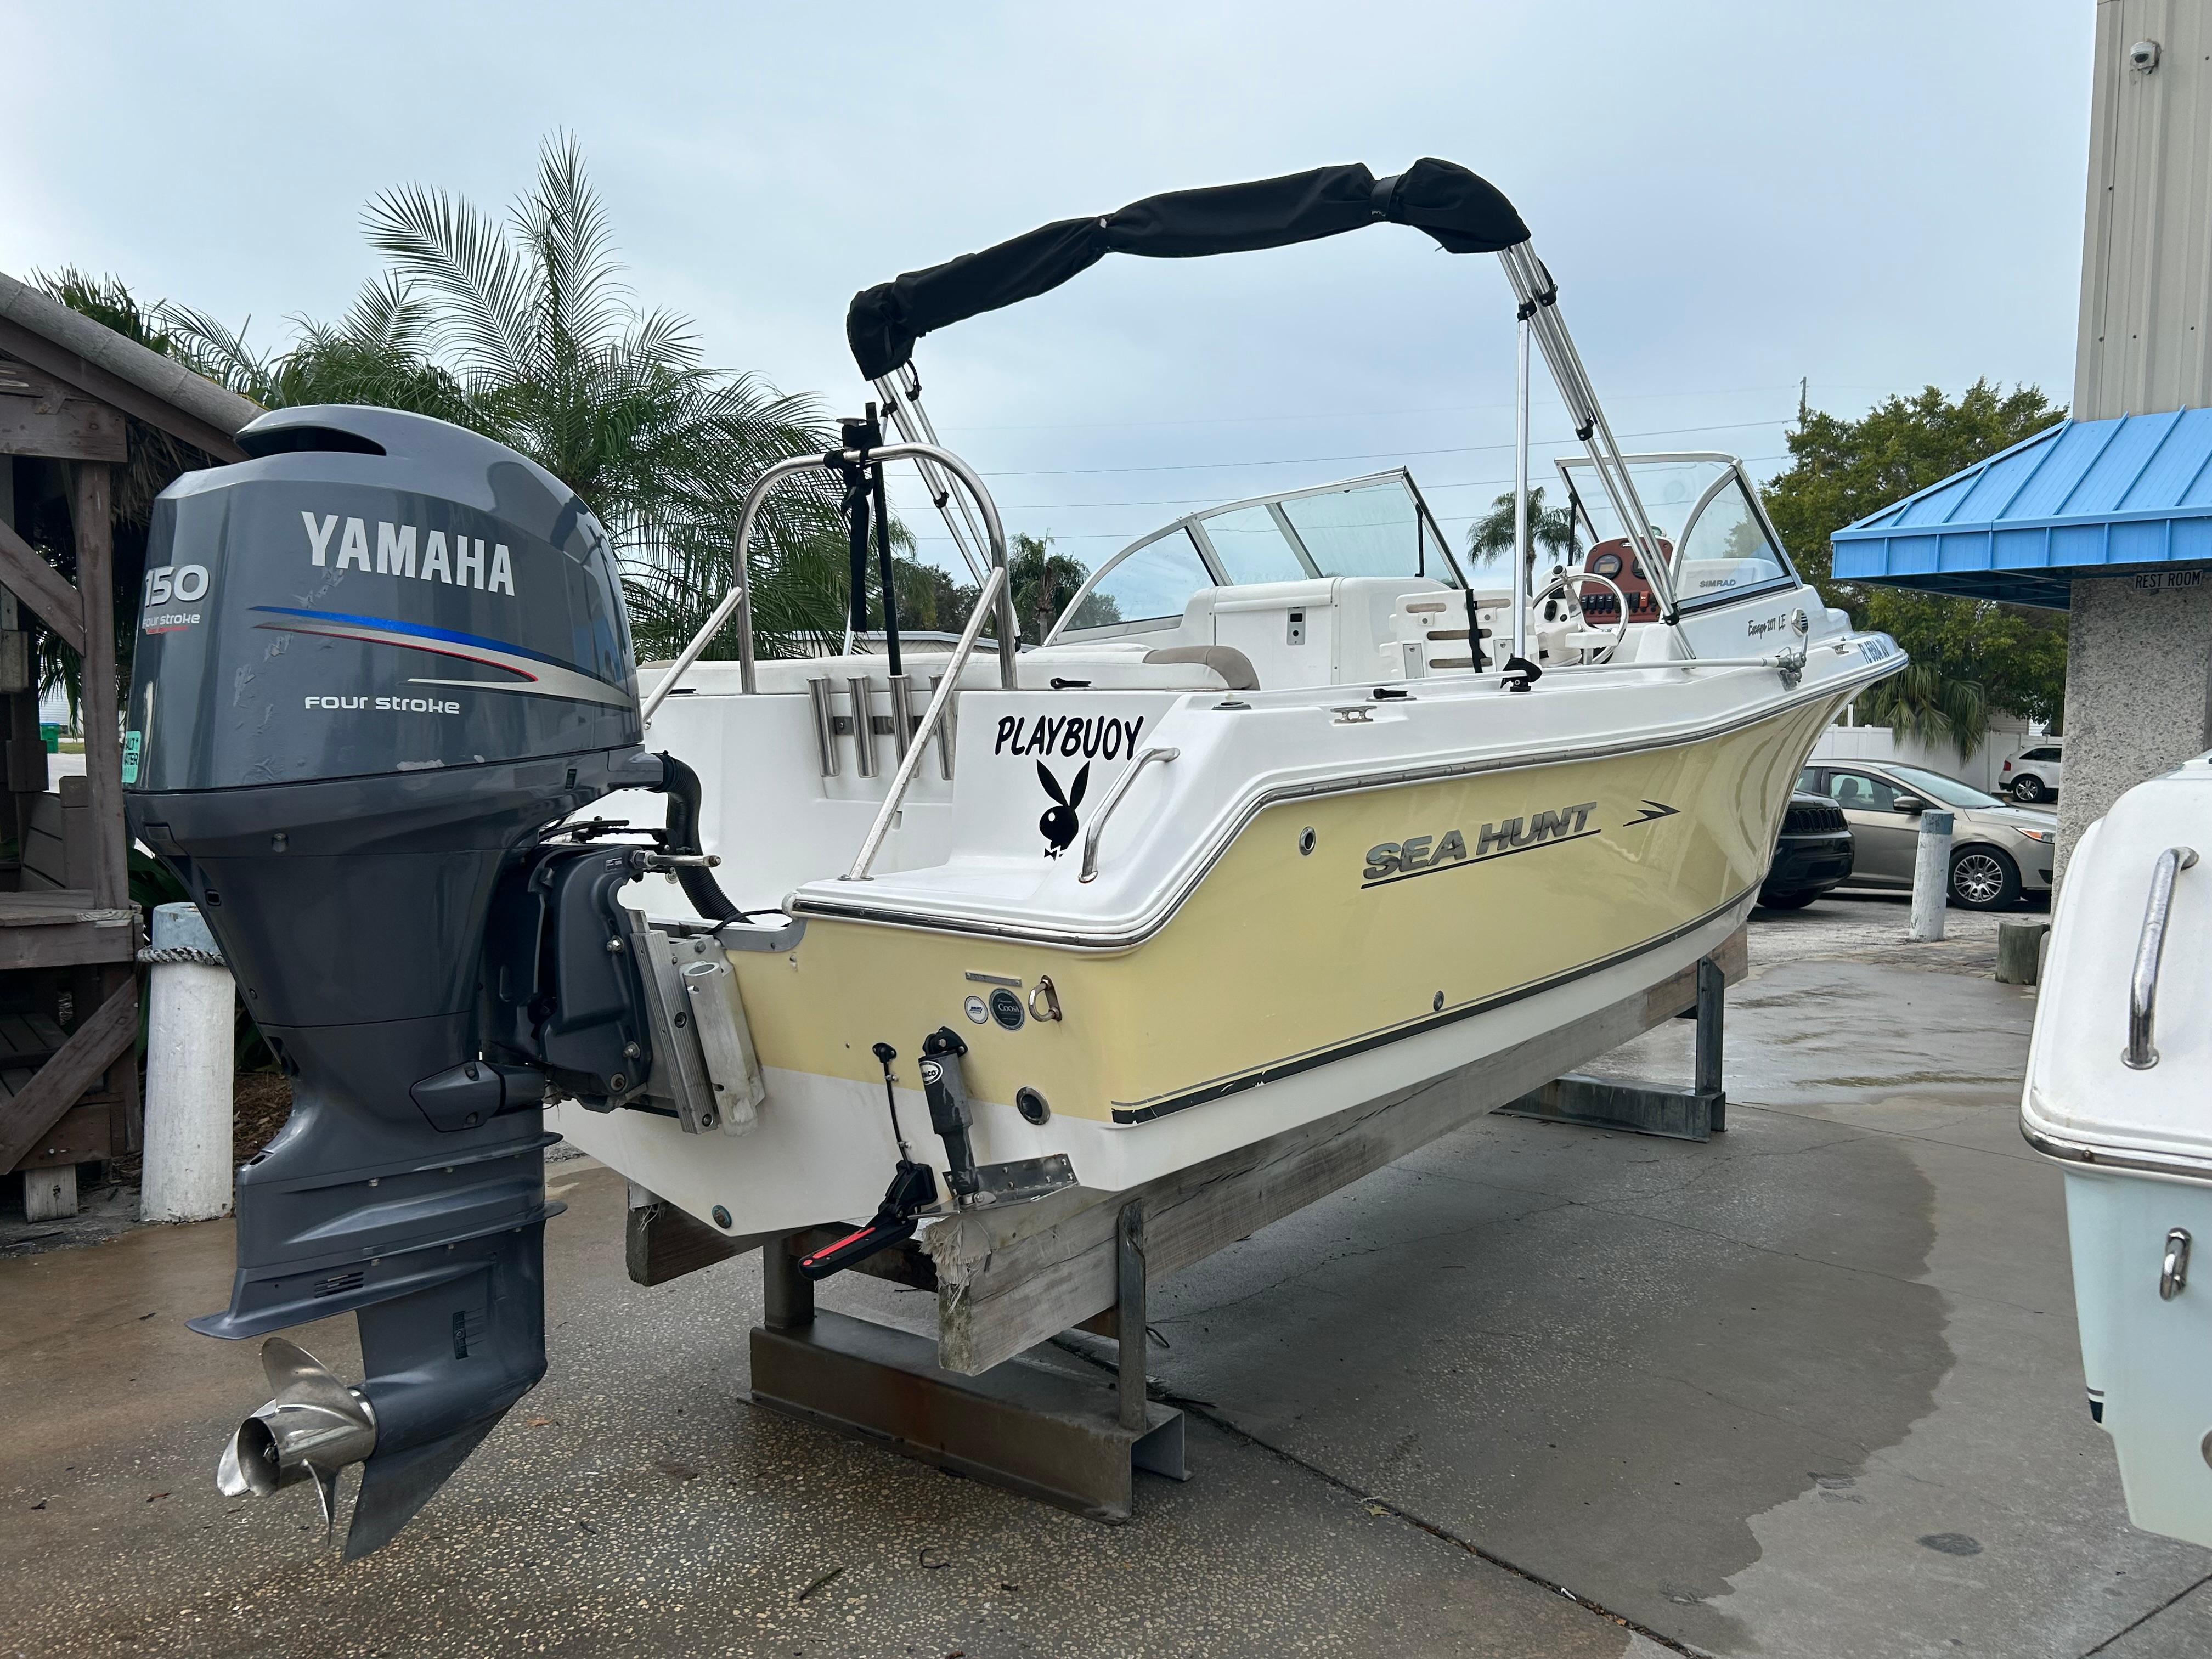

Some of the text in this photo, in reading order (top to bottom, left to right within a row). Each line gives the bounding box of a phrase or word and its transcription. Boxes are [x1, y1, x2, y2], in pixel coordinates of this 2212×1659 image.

[301, 511, 515, 597] YAMAHA
[145, 565, 210, 608] 150
[1699, 579, 1736, 588] SIMRAD
[2135, 570, 2202, 589] REST ROOM
[1778, 613, 1786, 631] LE
[994, 714, 1144, 761] PLAYBUOY
[1363, 801, 1597, 880] SEA HUNT
